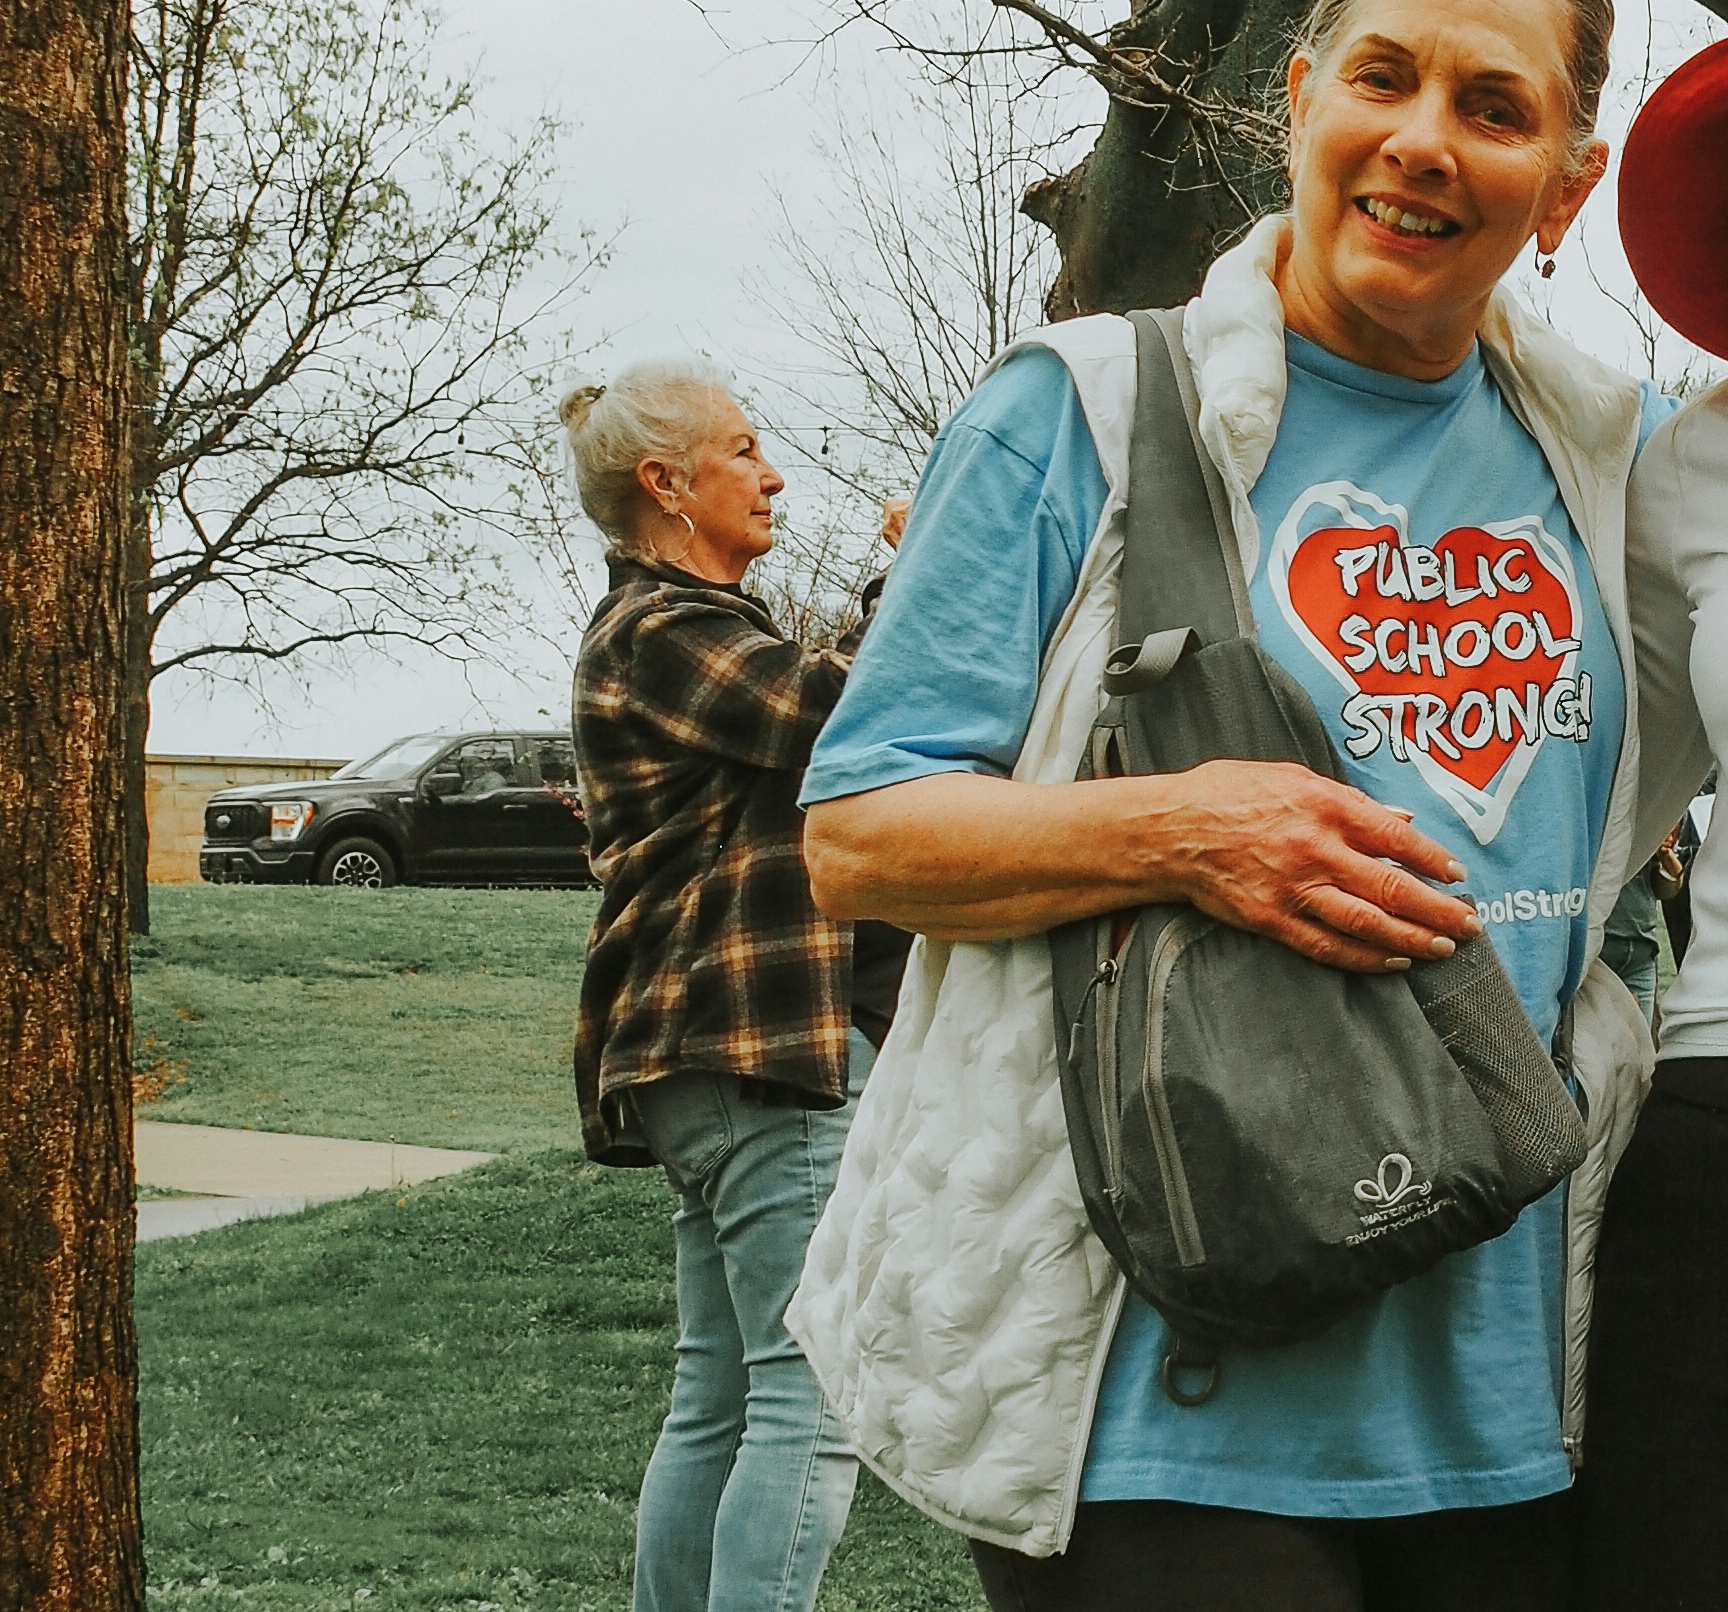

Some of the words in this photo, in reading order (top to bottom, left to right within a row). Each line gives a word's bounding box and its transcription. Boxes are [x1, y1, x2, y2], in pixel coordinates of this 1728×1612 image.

[1334, 541, 1533, 606] PUBLIC
[1339, 610, 1582, 678] SCHOOL
[1341, 672, 1592, 761] STRONG!
